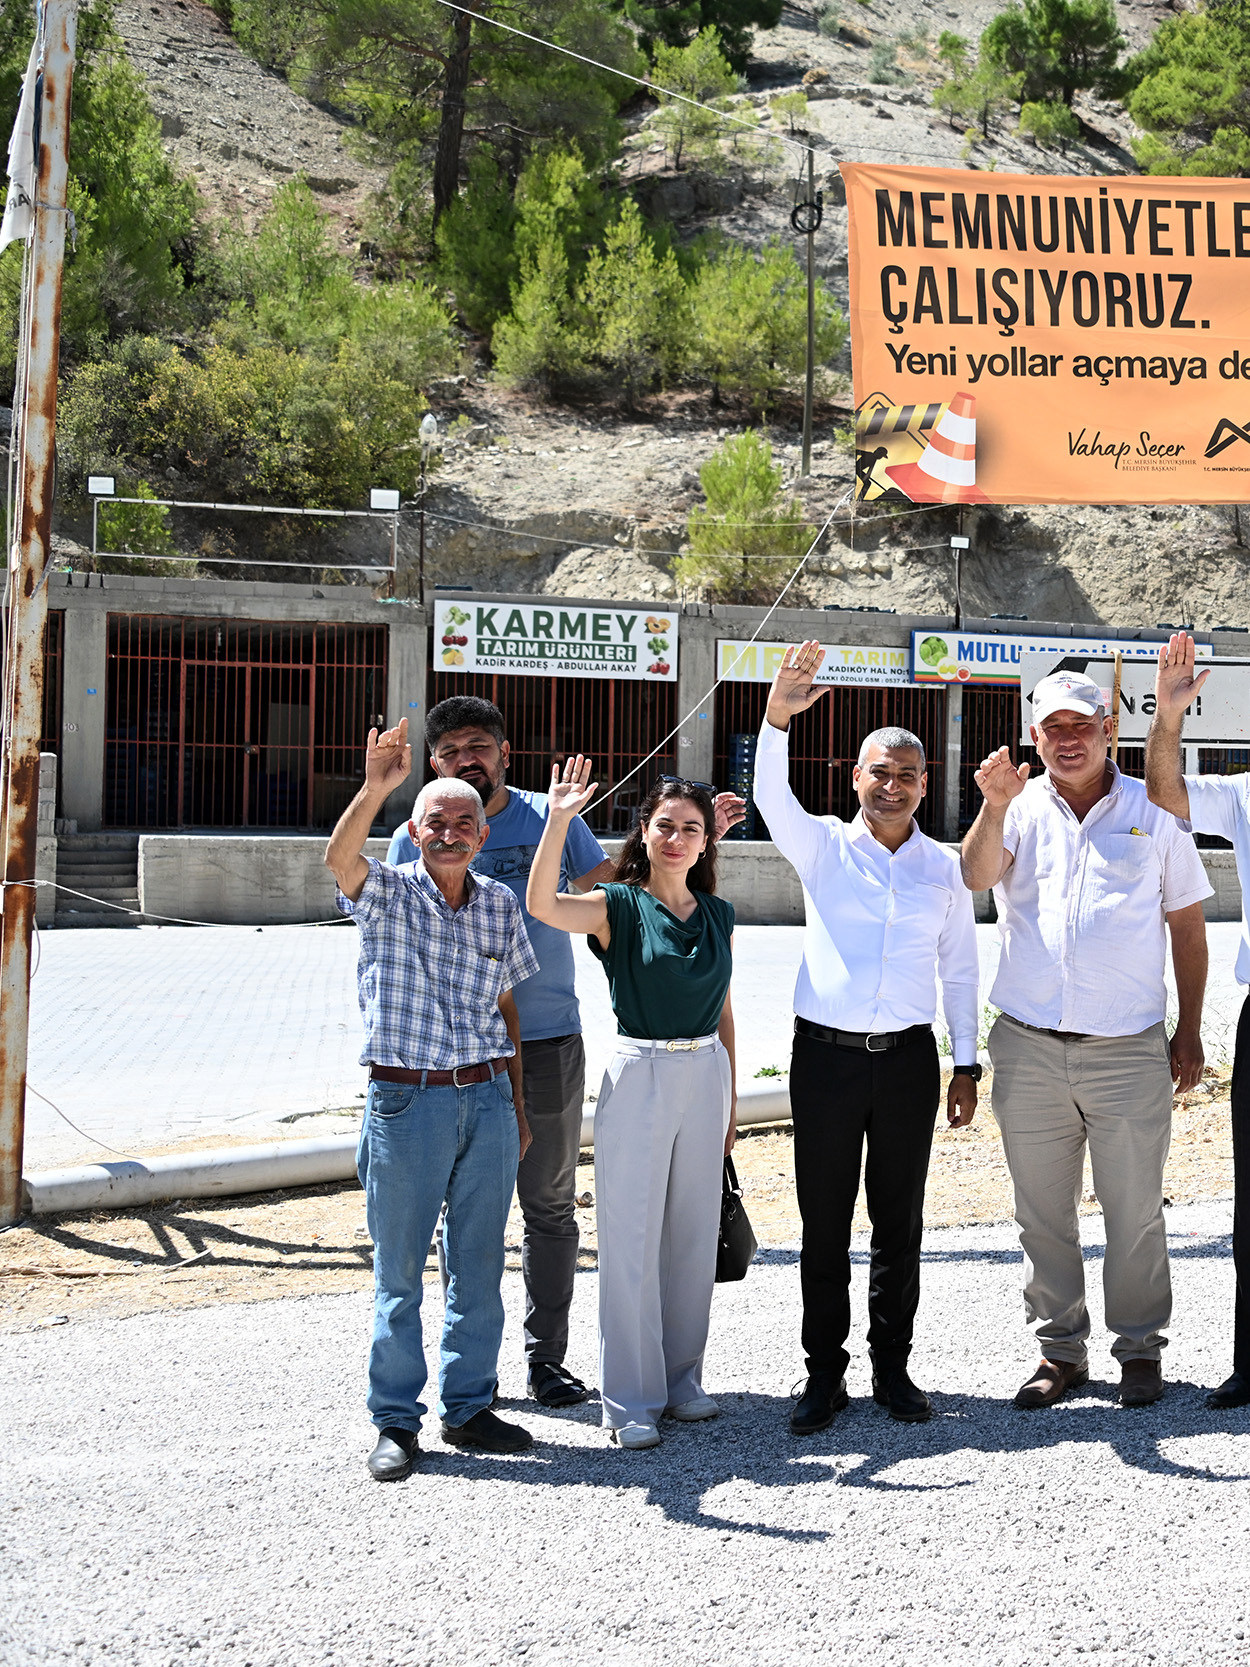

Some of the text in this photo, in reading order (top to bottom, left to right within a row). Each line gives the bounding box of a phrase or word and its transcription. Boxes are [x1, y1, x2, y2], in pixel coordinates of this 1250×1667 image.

[880, 265, 1210, 336] ÇALIŞIYORUZ.
[884, 343, 957, 375] Yeni
[966, 346, 1063, 384] yollar
[1072, 354, 1208, 386] açmaya
[1068, 428, 1185, 470] Vahap Seçer
[1151, 465, 1177, 473] BAŞKANI
[1158, 458, 1197, 466] BÜYÜKŞEHİR
[476, 607, 638, 643] KARMEY
[481, 640, 633, 661] TARIM ÜRÜNLERİ
[840, 650, 905, 667] TARIM
[957, 640, 1022, 664] MUTLU
[475, 658, 506, 667] KADİR
[509, 660, 548, 671] KARDEŞ
[557, 661, 608, 671] ABDULLAH
[610, 664, 637, 672] AKAY
[722, 645, 806, 679] MR
[828, 665, 869, 674] KADIKÖY
[870, 666, 887, 675] HAL
